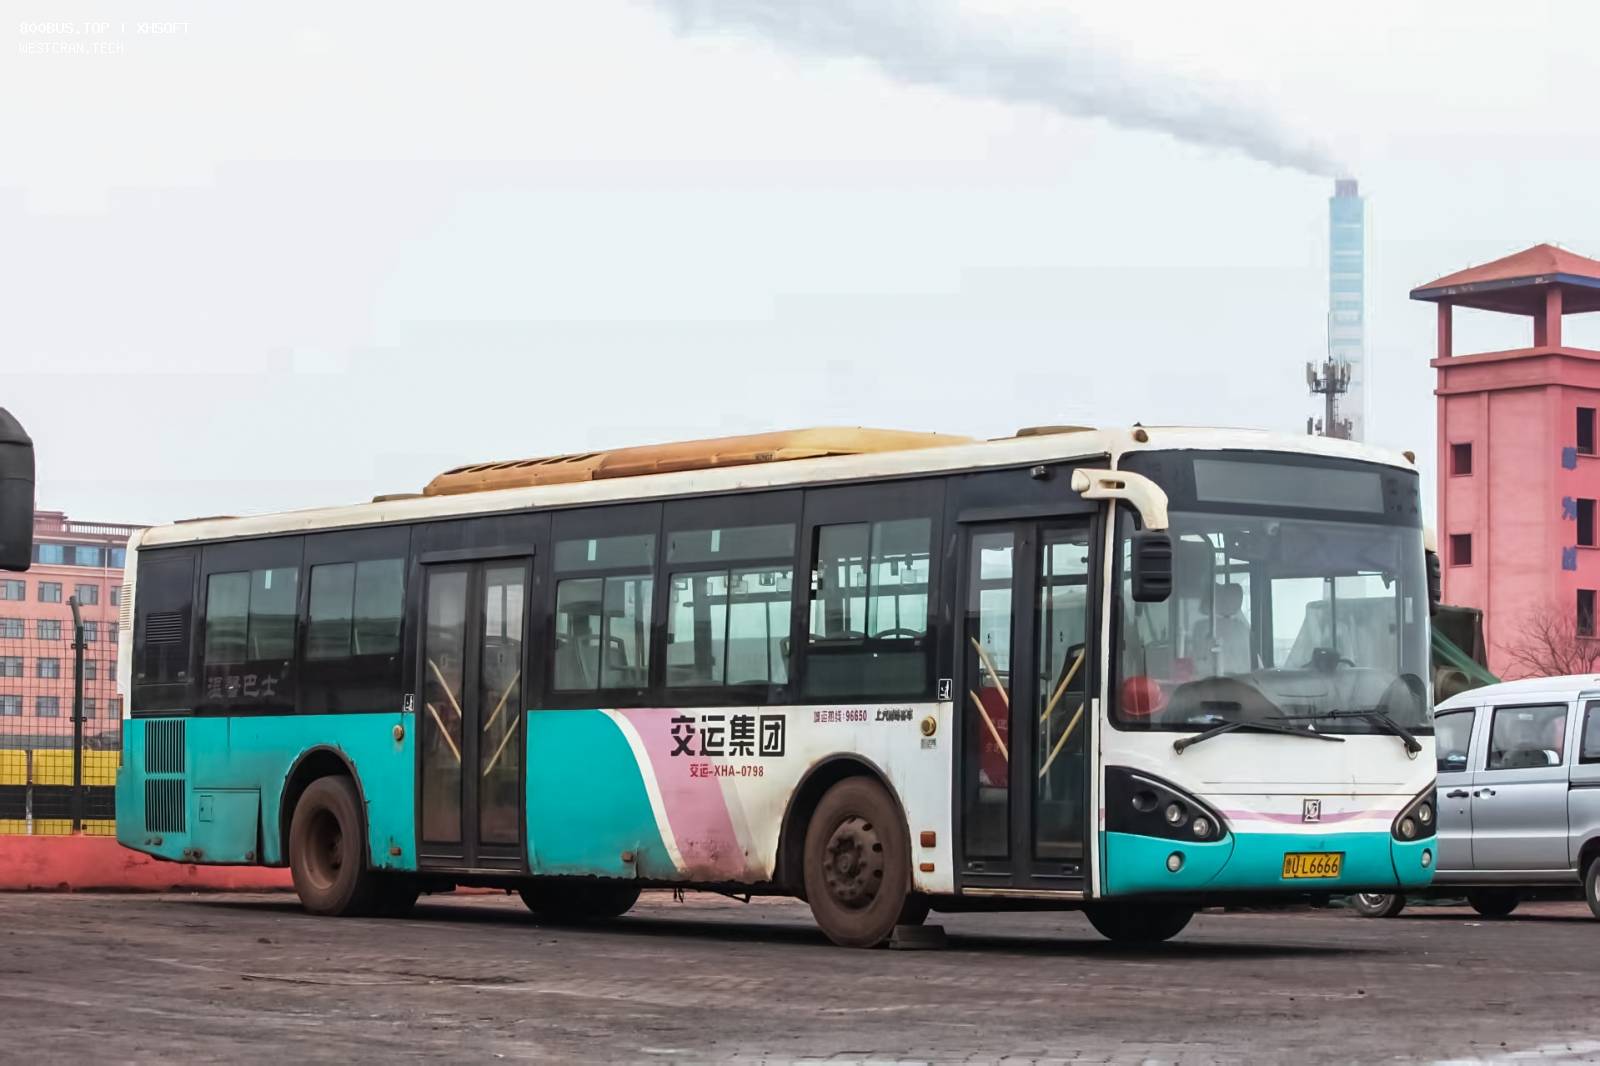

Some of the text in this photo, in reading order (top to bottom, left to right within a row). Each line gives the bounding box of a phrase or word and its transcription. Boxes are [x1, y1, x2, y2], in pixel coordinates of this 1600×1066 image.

[670, 714, 786, 757] 交运集团
[690, 763, 764, 778] 交运-XHA-0798
